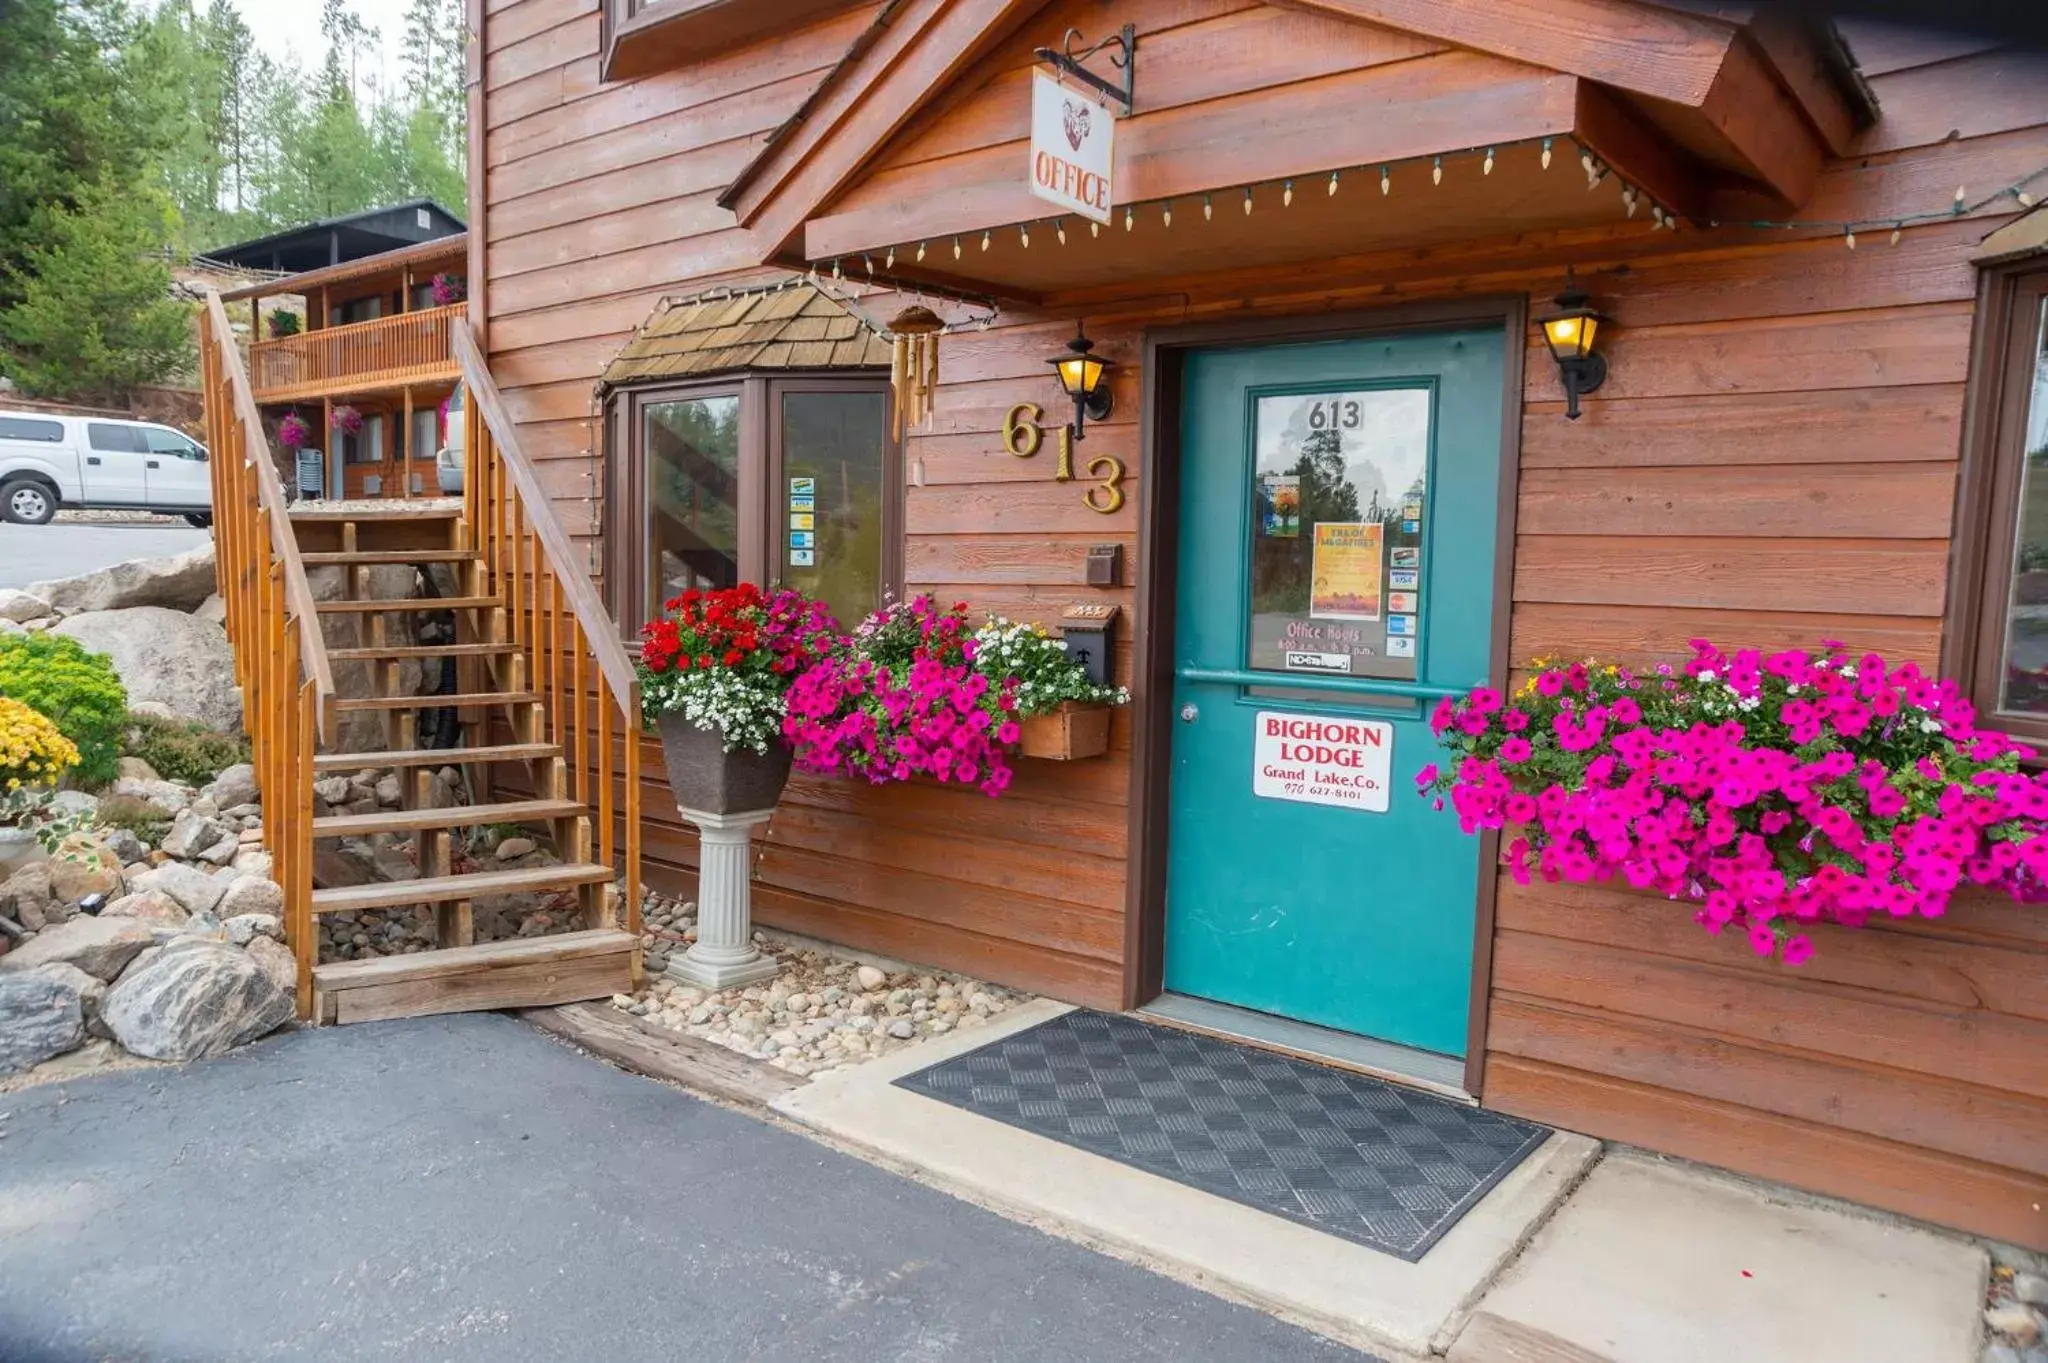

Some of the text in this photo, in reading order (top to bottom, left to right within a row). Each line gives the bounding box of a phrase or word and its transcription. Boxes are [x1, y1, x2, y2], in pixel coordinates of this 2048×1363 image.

[1035, 150, 1108, 211] OFFICE
[1309, 401, 1359, 429] 613
[1002, 402, 1125, 514] 613
[1286, 622, 1360, 642] Office Hours
[1266, 718, 1381, 747] BIGHORN
[1280, 742, 1364, 768] LODGE
[1263, 765, 1305, 781] Grand
[1284, 783, 1305, 794] 970
